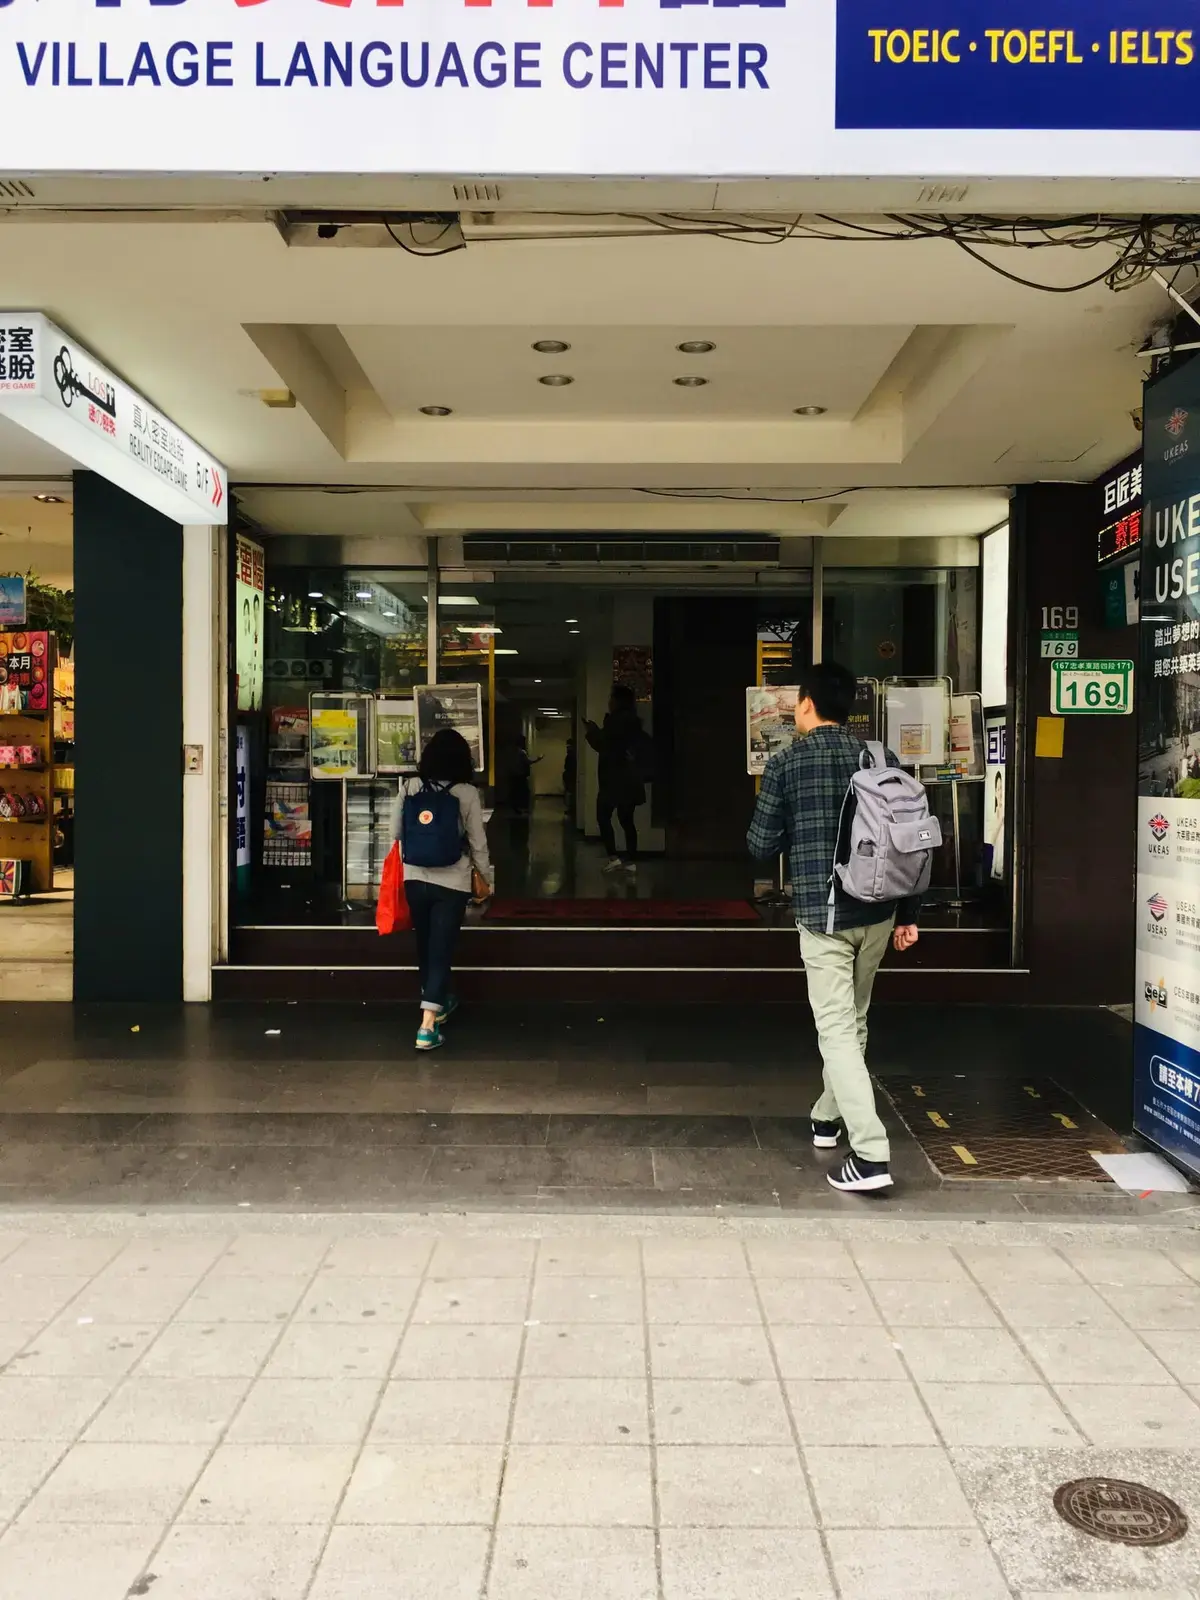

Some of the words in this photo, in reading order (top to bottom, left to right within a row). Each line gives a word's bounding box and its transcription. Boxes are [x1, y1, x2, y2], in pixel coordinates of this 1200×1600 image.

[868, 29, 960, 63] TOEIC
[985, 29, 1083, 64] TOEFL
[1109, 30, 1194, 65] IELTS
[16, 41, 234, 87] VILLAGE
[255, 41, 542, 89] LANGUAGE
[562, 42, 770, 89] CENTER
[1163, 439, 1189, 461] UKEAS
[1155, 493, 1200, 548] UKE
[1155, 552, 1200, 603] USE
[1041, 606, 1079, 629] 169
[1044, 642, 1076, 656] 169
[9, 656, 30, 670] 本月
[1066, 681, 1121, 707] 169
[1148, 843, 1170, 856] UKEAS
[1147, 922, 1168, 937] USEAS
